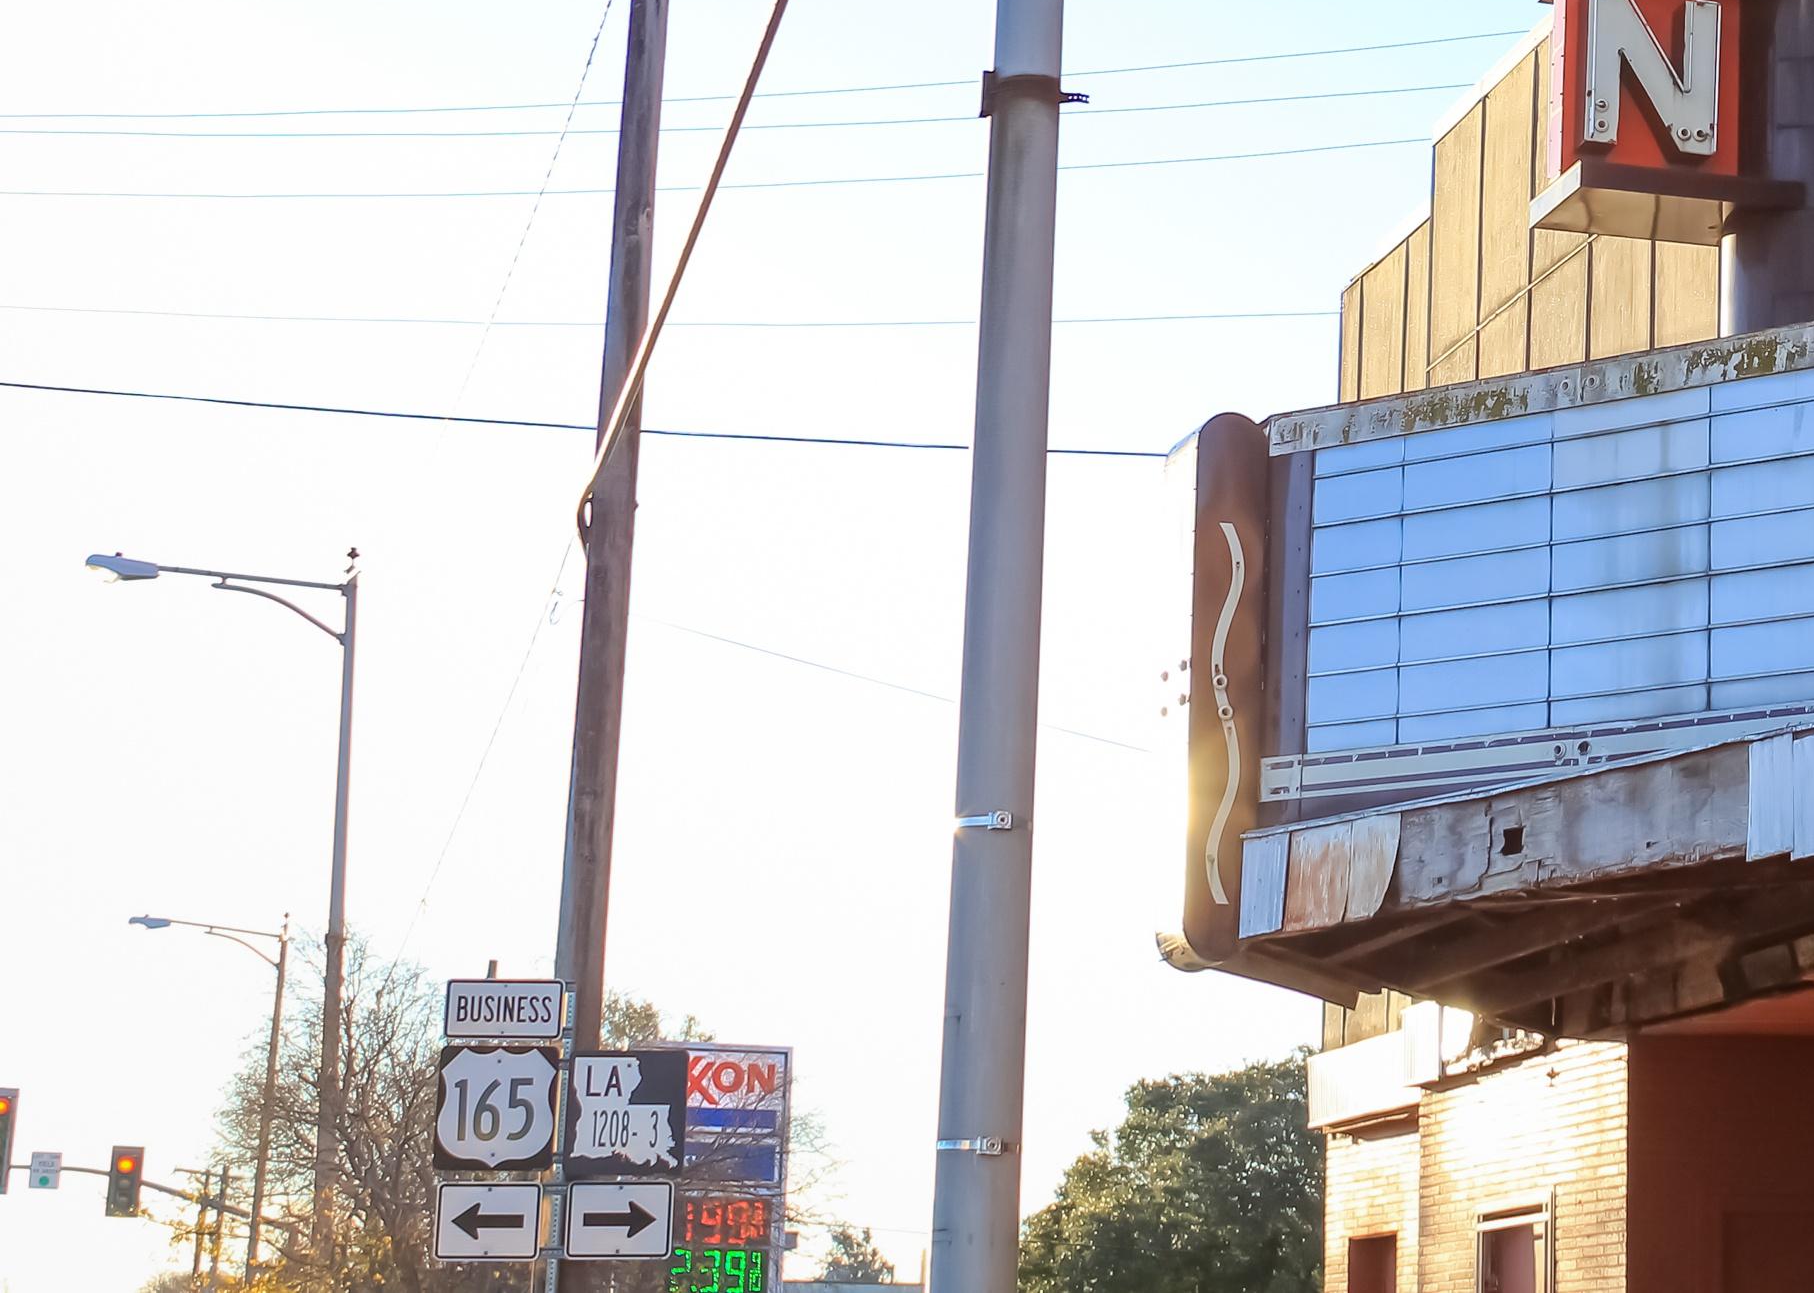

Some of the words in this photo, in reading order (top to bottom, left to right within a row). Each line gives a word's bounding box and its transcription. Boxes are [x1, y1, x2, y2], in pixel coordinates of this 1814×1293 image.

[456, 995, 552, 1023] BUSINESS
[585, 1065, 622, 1097] LA
[688, 1055, 776, 1106] XON
[454, 1077, 535, 1141] 165
